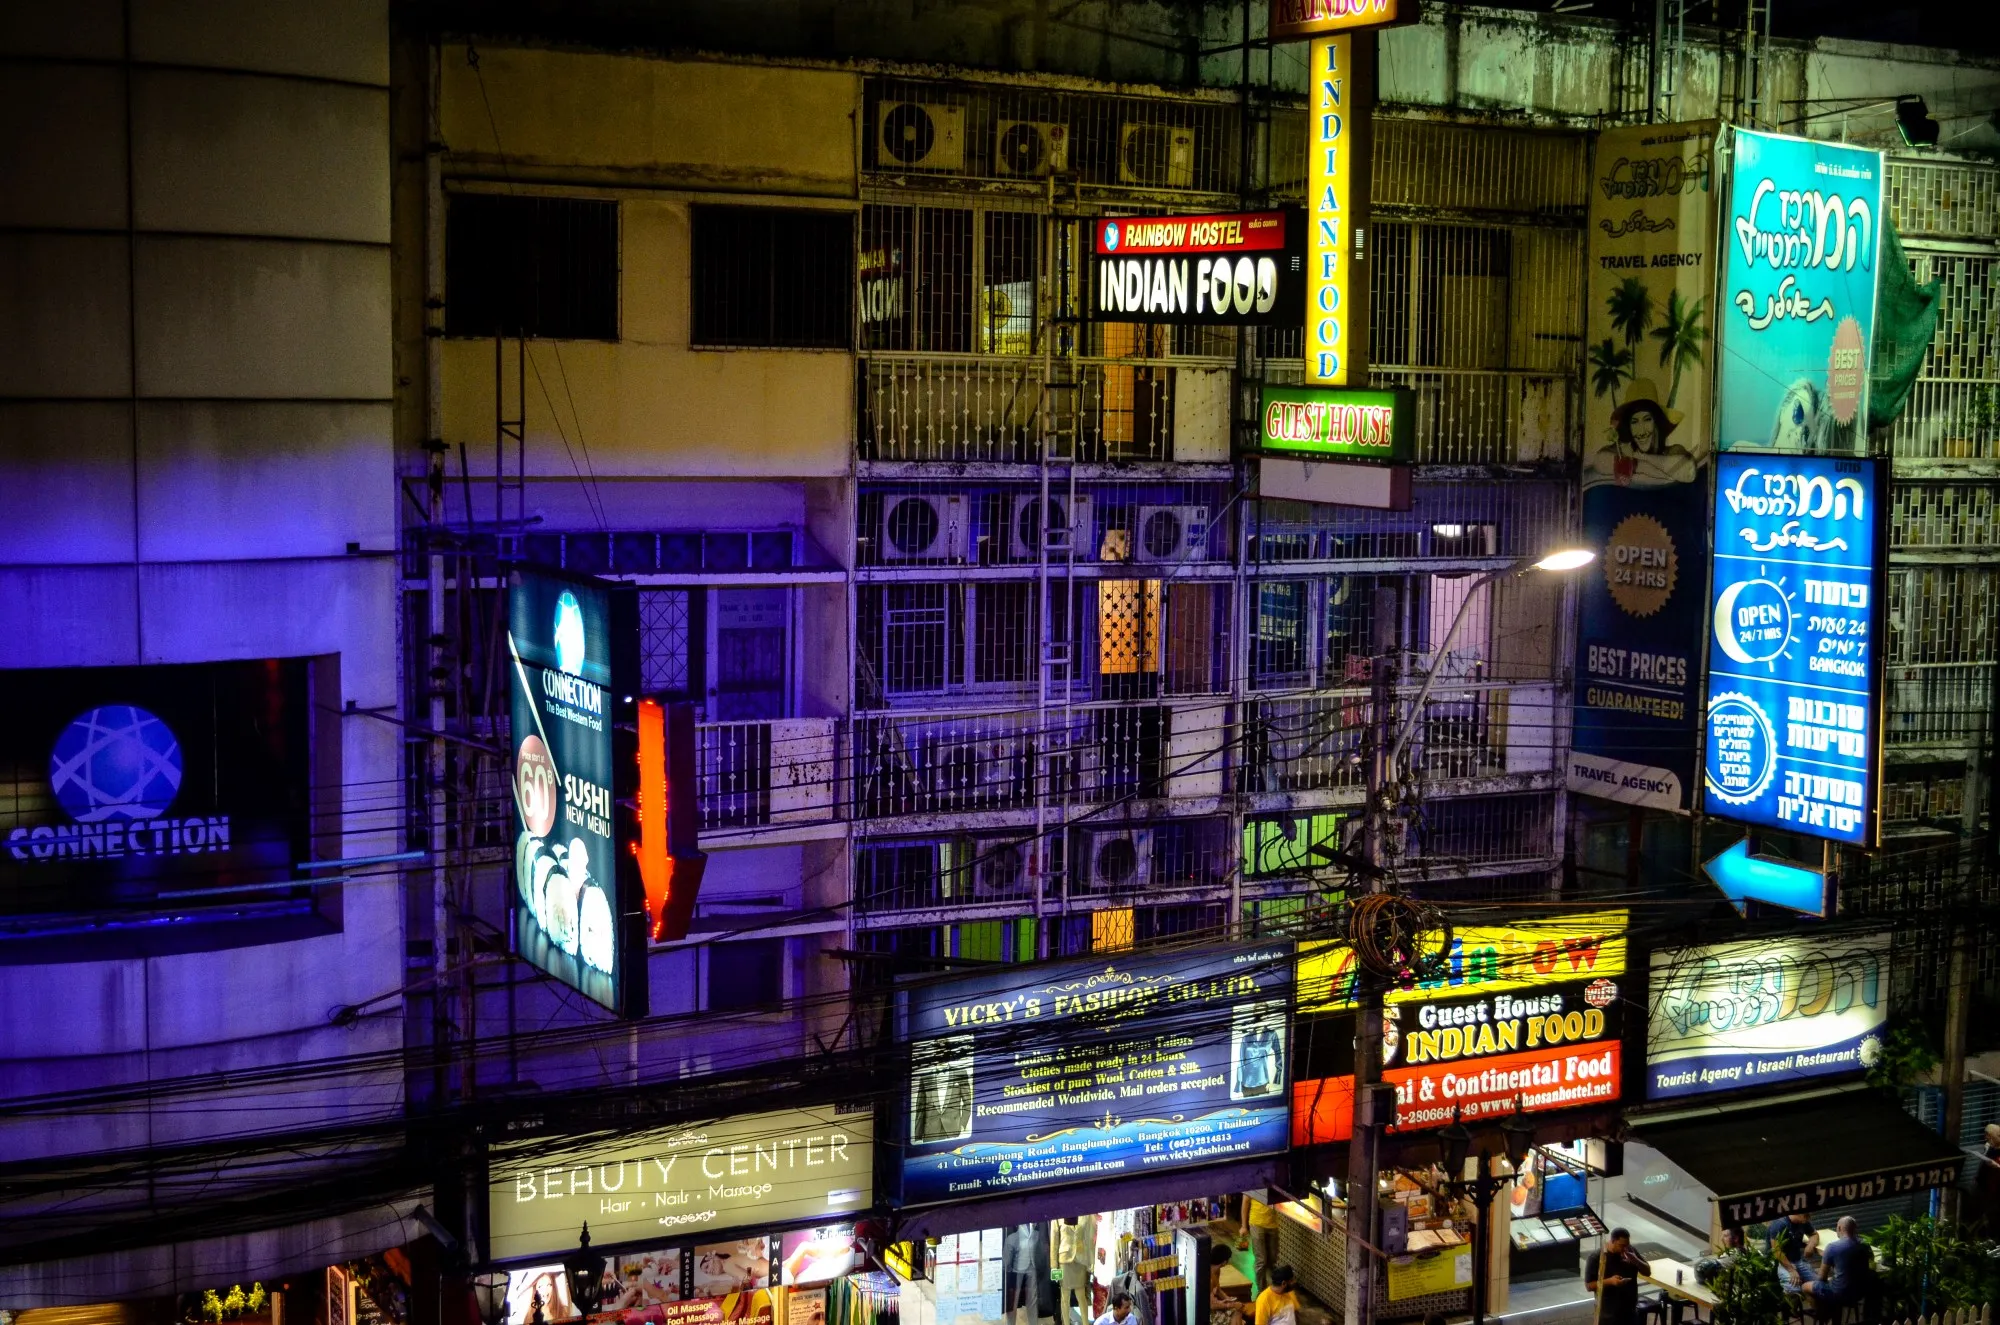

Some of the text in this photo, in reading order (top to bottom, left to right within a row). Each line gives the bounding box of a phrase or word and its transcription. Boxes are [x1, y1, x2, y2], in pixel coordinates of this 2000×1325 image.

[1125, 220, 1244, 247] RAINBOW HOSTEL
[1600, 252, 1703, 269] TRAVEL AGENCY
[1100, 256, 1277, 315] INDIAN FOOD
[1834, 348, 1860, 370] BEST
[1834, 374, 1857, 386] PRICES
[1266, 400, 1393, 447] GUEST HOUSE
[1614, 545, 1667, 568] OPEN
[1614, 568, 1667, 588] 24 HRS
[1804, 578, 1868, 608] פתוח
[1738, 603, 1782, 627] OPEN
[1848, 621, 1867, 636] 24
[1739, 627, 1782, 643] 24/7 HRS
[1588, 645, 1687, 687] BEST PRICES
[1809, 655, 1865, 678] BANGKOK
[543, 668, 602, 714] CONNECTION
[1587, 687, 1684, 720] GUARANTEED!
[546, 700, 555, 714] The
[555, 703, 567, 719] Best
[588, 715, 602, 732] Food
[564, 773, 610, 820] SUSHI
[1574, 764, 1673, 796] TRAVEL AGENCY
[566, 804, 611, 839] NEW MENU
[10, 816, 230, 862] CONNECTION
[944, 995, 1041, 1028] VICKY'S
[1054, 986, 1159, 1016] FASHION
[1419, 1001, 1489, 1028] Guest
[1494, 993, 1564, 1021] House
[1406, 1008, 1605, 1064] INDIAN FOOD
[1003, 1082, 1051, 1098] Stockiest
[1054, 1079, 1065, 1091] of
[1068, 1078, 1092, 1093] pure
[1129, 1068, 1164, 1080] Cotton
[1167, 1064, 1177, 1076] &
[1021, 1066, 1061, 1079] Clothes
[1064, 1061, 1092, 1074] made
[1096, 1056, 1125, 1070] ready
[1128, 1055, 1138, 1065] in
[1141, 1053, 1152, 1064] 24
[1420, 1076, 1435, 1102] &
[1442, 1059, 1559, 1099] Continental
[1565, 1051, 1612, 1081] Food
[1656, 1048, 1855, 1089] Tourist Agency & Israeli Restaurant
[976, 1074, 1226, 1117] Recommended Worldwide, Mail orders accepted.
[937, 1162, 949, 1170] 41
[953, 1151, 1024, 1168] Chakraphong
[1062, 1135, 1134, 1153] Banglumphoo,
[1138, 1128, 1181, 1143] Bangkok
[1216, 1117, 1261, 1131] Thailand.
[1144, 1143, 1164, 1153] Tel:
[516, 1133, 849, 1203] BEAUTY CENTER
[949, 1141, 1251, 1192] Email: vickysfashion@hotmail.com www.vickysfashion.net
[600, 1181, 773, 1215] Hair Nails Massage
[1729, 1166, 1956, 1221] המרכז למטייל תאילנד
[683, 1251, 691, 1296] MASSAGE
[771, 1240, 781, 1283] WAX
[667, 1301, 713, 1316] Oil Massage
[667, 1311, 719, 1325] Foot Massage
[738, 1315, 771, 1325] Massage
